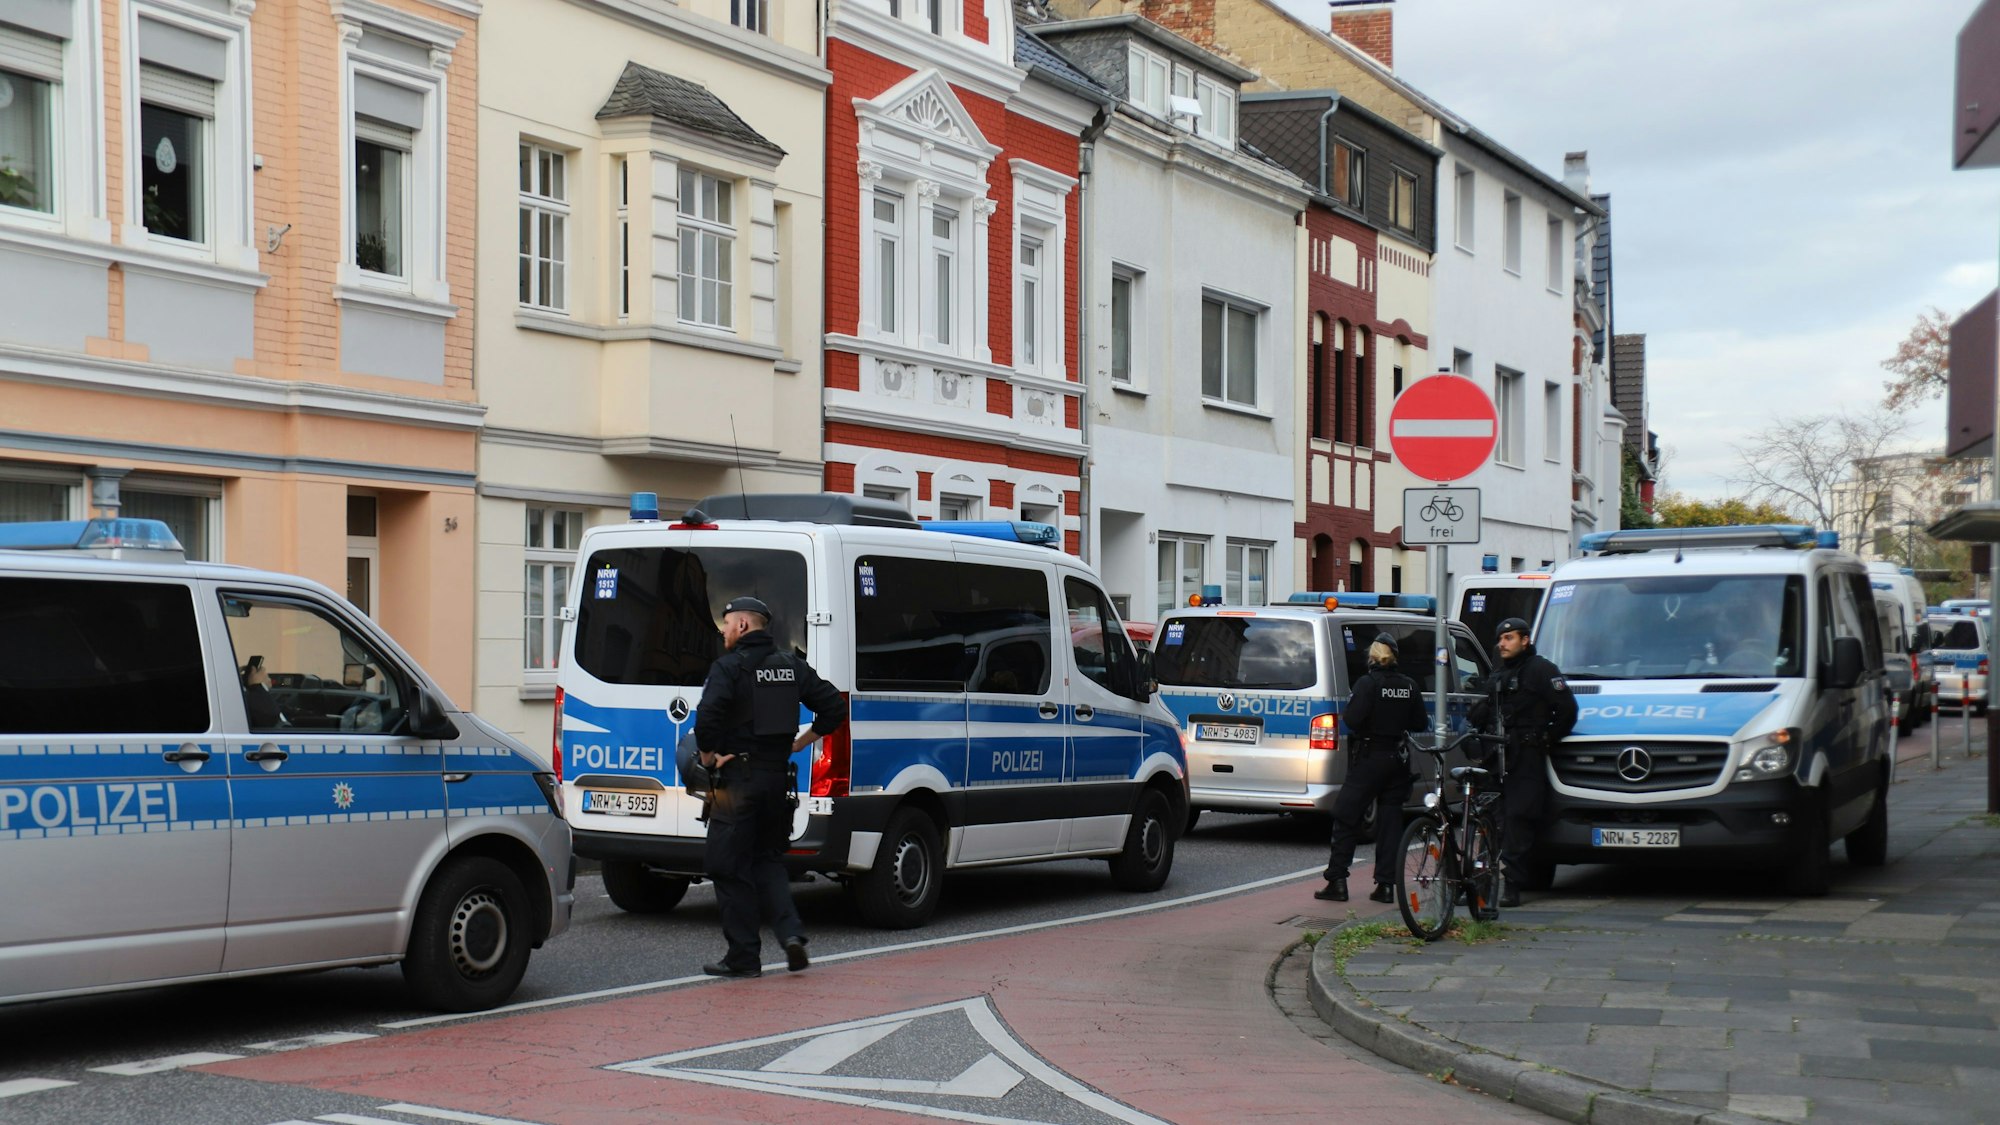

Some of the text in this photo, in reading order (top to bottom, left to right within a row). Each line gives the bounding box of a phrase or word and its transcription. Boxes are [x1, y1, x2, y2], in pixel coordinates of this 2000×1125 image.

[1430, 525, 1454, 537] frei
[597, 569, 618, 578] NRW
[859, 566, 873, 576] NRW
[598, 580, 615, 588] 1513
[861, 577, 874, 586] 1513
[756, 669, 795, 682] POLIZEI
[1382, 688, 1410, 698] POLIZEI
[1237, 698, 1311, 716] POLIZEI
[1578, 704, 1707, 720] POLIZEI
[1202, 726, 1219, 737] NRW
[572, 744, 663, 771] POLIZEI
[991, 750, 1043, 773] POLIZEI
[0, 783, 178, 829] POLIZEI
[590, 793, 610, 808] NRW
[1601, 831, 1624, 844] NRW
